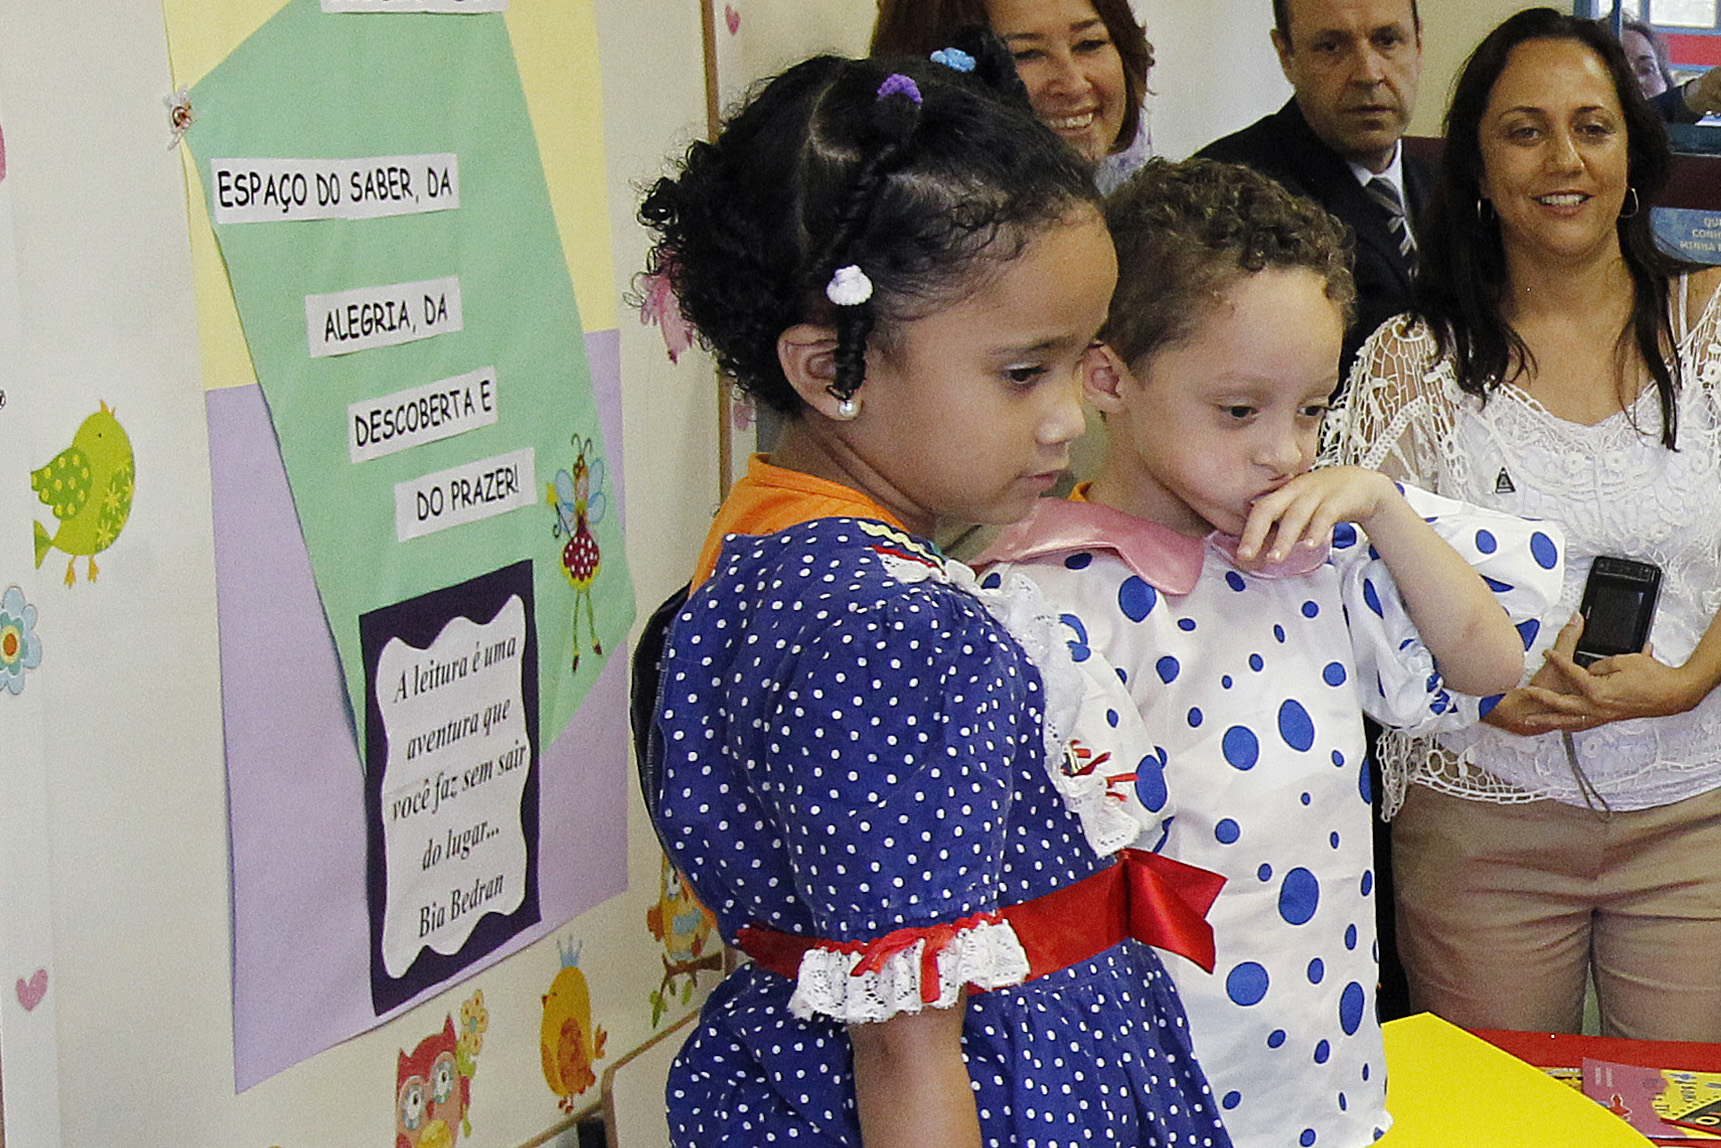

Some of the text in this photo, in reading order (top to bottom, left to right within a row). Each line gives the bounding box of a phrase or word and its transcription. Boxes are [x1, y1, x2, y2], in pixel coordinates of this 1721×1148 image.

[217, 166, 453, 213] ESPAÇO DO SABER, DA
[325, 293, 448, 342] ALEGRIA, DA
[355, 379, 492, 447] DESCOBERTA E
[417, 463, 520, 521] DO PRAZER!
[393, 636, 517, 703] A leitura é uma
[407, 699, 511, 760] aventura que
[393, 739, 527, 820] você faz sem sair
[422, 821, 500, 871] do lugar...
[420, 874, 504, 938] Bia Bedran
